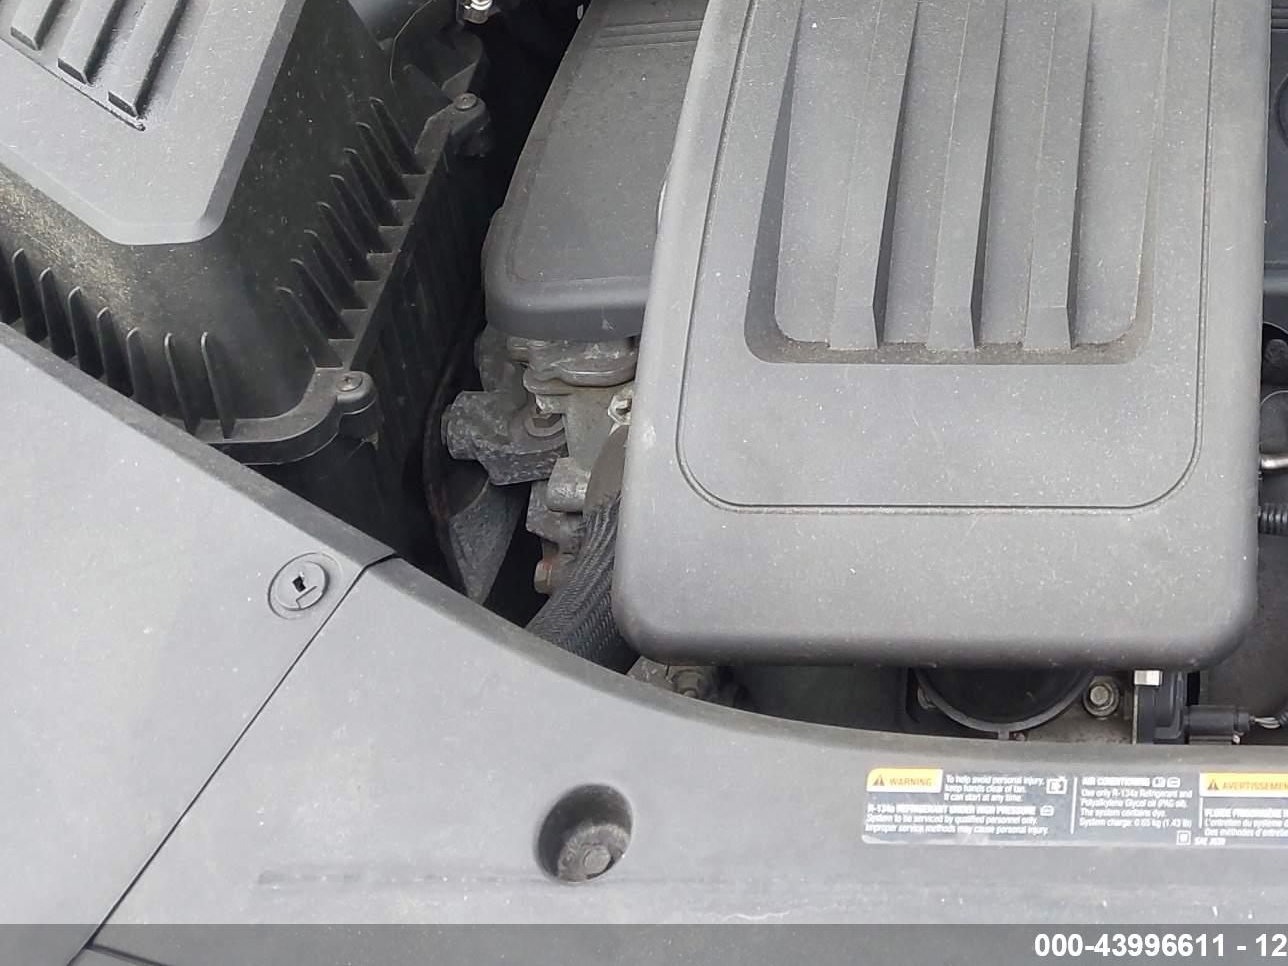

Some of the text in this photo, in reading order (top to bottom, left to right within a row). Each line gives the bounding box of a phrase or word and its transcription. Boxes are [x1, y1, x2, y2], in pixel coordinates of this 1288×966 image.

[889, 777, 932, 786] WARNING
[946, 775, 955, 783] To
[956, 775, 970, 785] help
[973, 775, 991, 783] avoid
[993, 776, 1022, 785] personal
